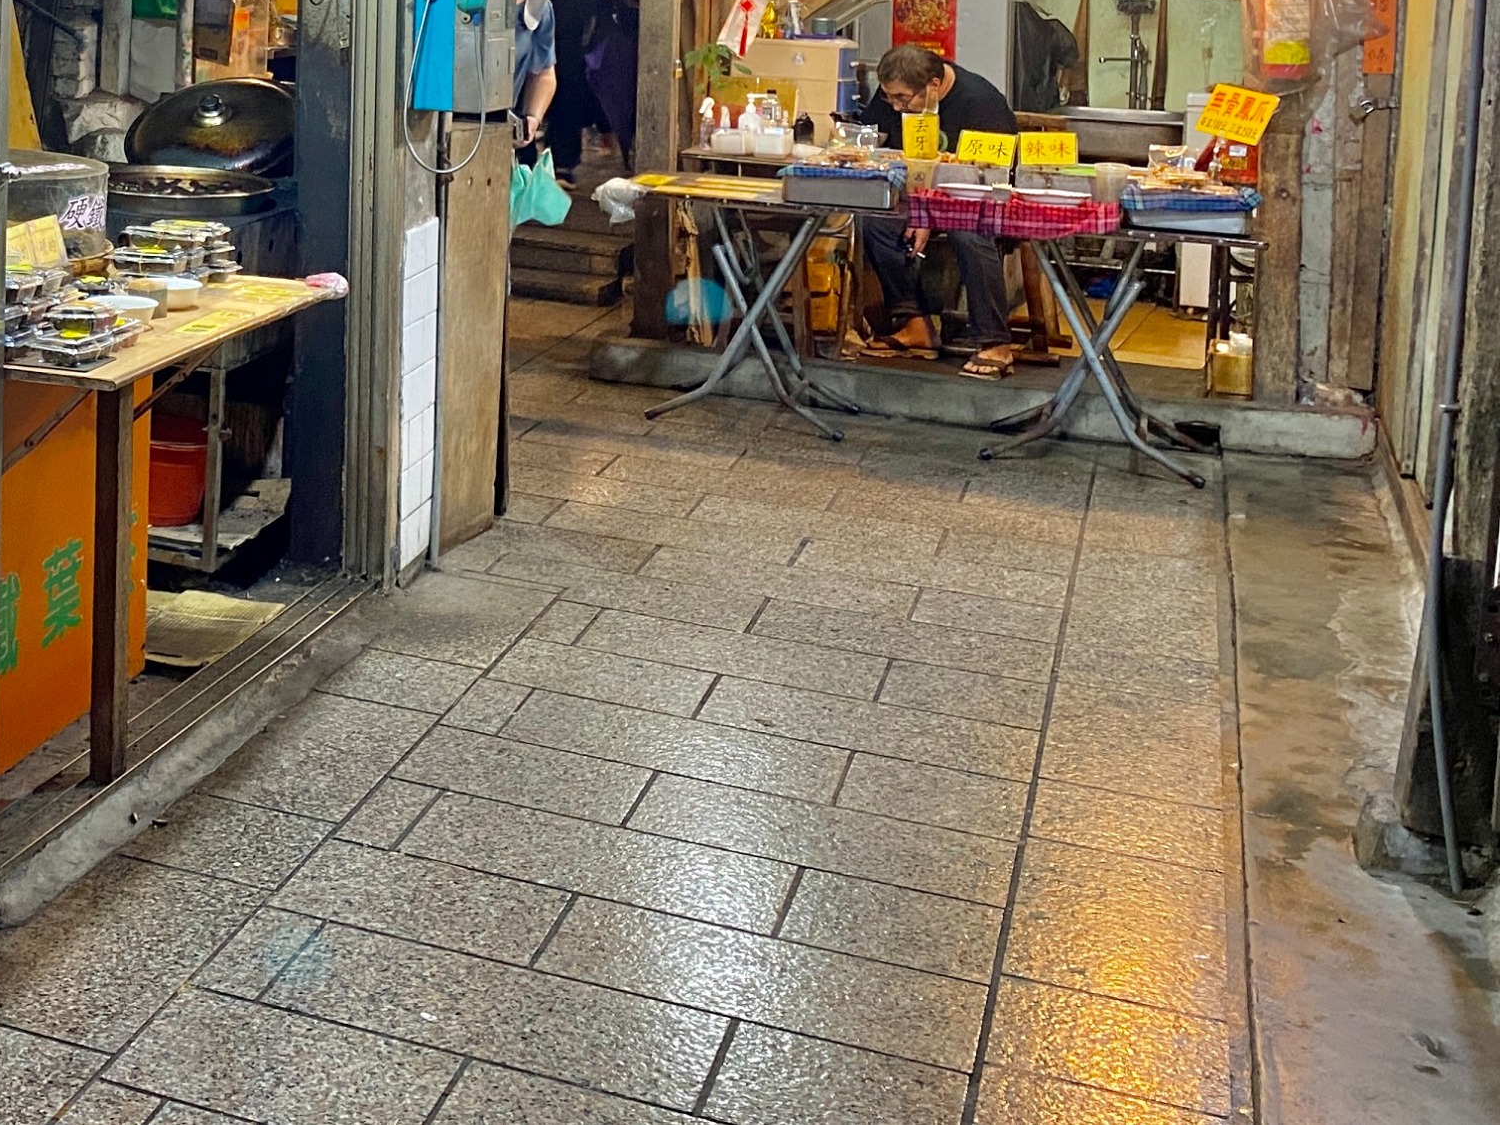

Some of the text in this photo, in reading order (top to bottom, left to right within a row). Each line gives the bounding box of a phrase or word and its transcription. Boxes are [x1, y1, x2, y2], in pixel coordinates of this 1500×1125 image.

[913, 118, 929, 158] 丟牙
[965, 138, 1008, 159] 原味
[1025, 139, 1072, 159] 辣味
